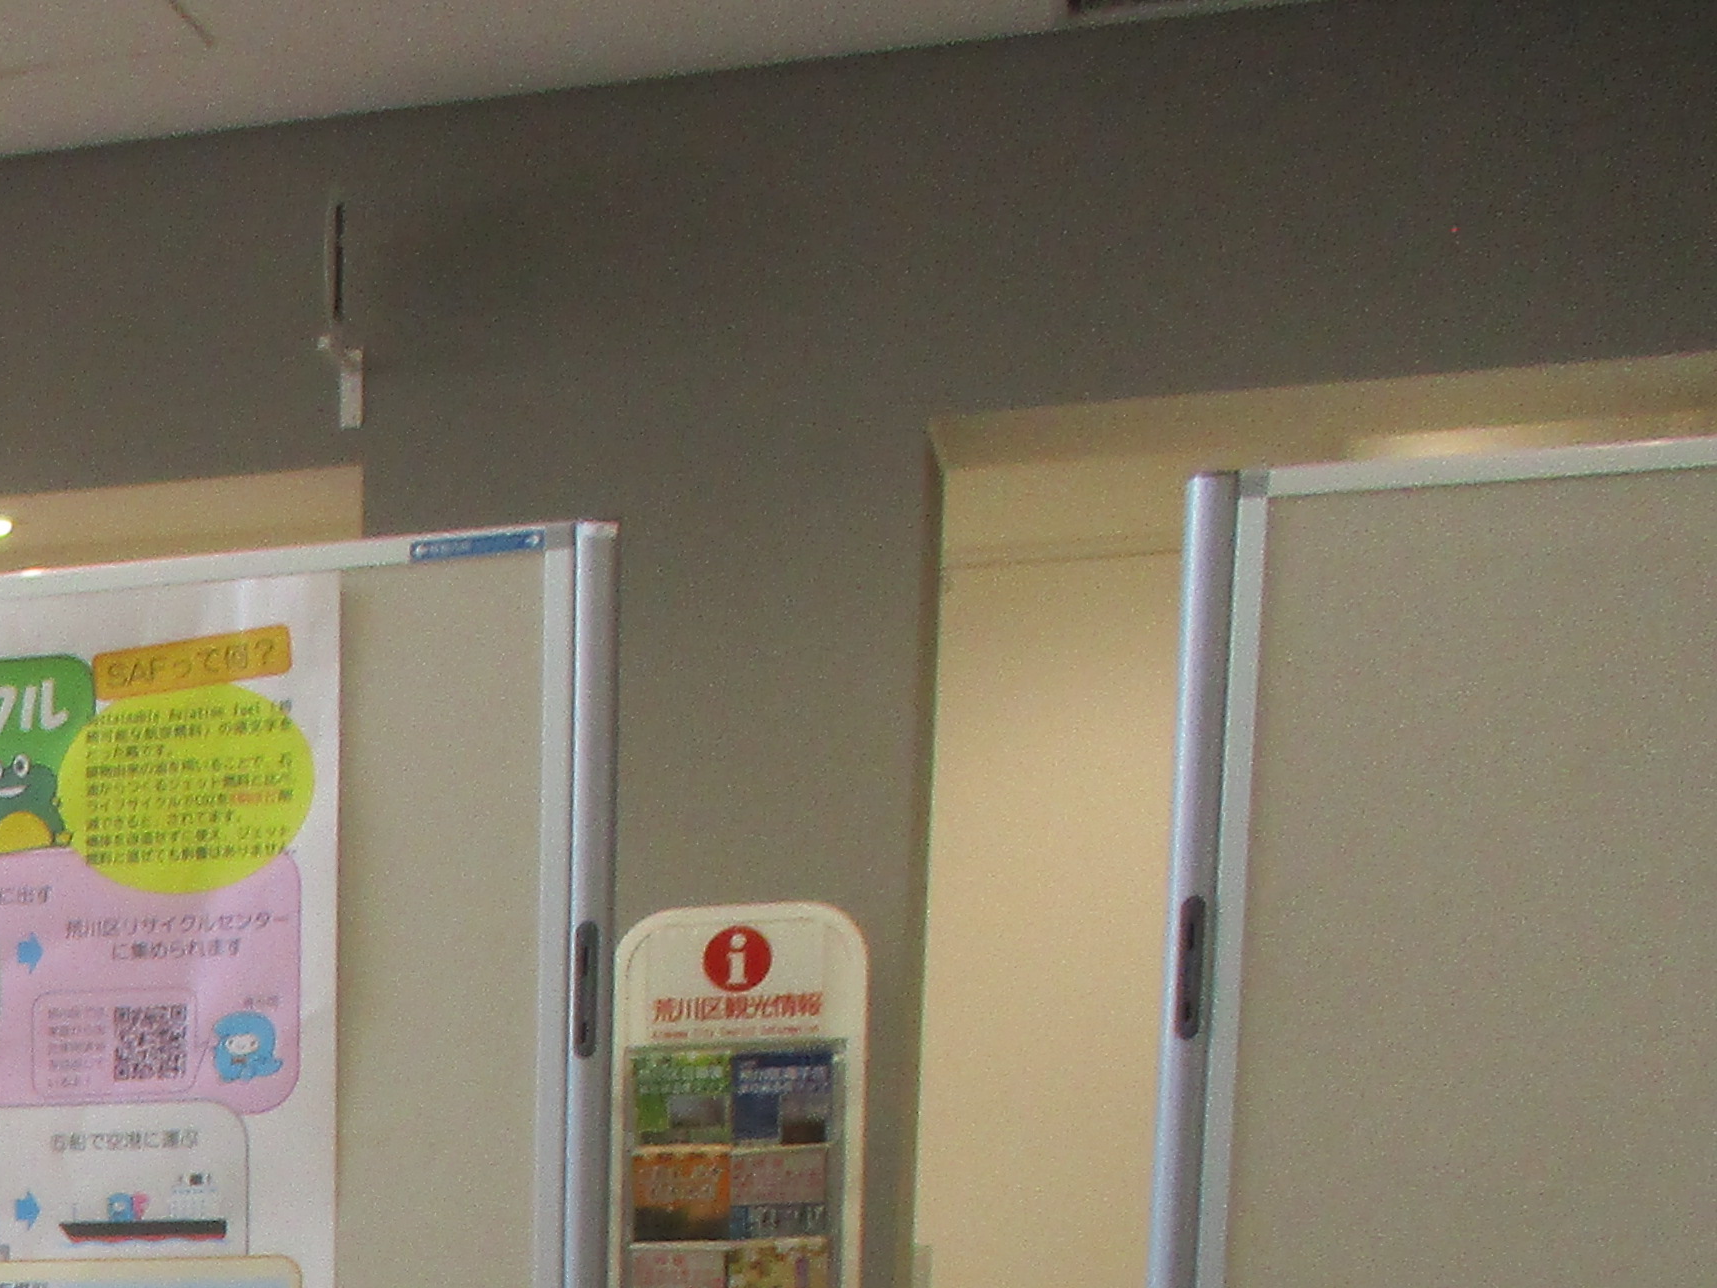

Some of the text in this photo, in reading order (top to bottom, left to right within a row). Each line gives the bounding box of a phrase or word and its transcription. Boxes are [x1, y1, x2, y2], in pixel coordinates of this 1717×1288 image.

[107, 638, 274, 687] SAFって何？
[65, 911, 290, 939] 荒川区リサイクルセンター
